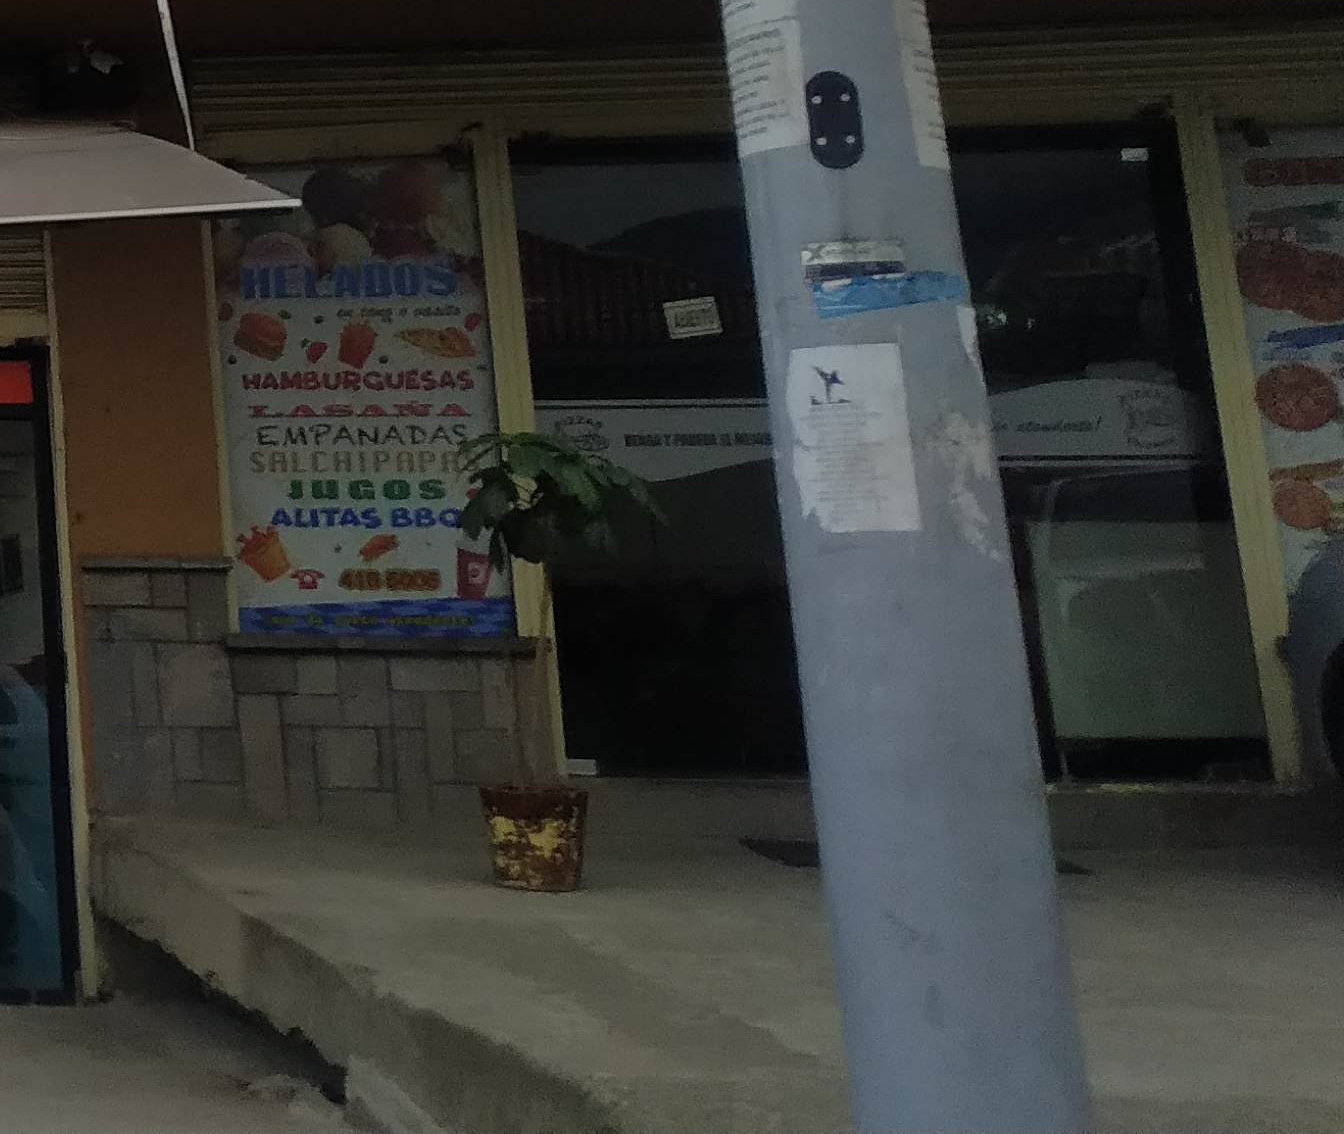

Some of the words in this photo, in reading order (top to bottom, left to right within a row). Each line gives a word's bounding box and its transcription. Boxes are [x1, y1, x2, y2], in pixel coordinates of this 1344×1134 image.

[242, 264, 458, 300] HELADOS
[242, 370, 475, 391] HAMBURGUESAS
[257, 424, 469, 447] EMPANADAS
[287, 479, 446, 501] JUGOS
[271, 507, 382, 530] ALITAS
